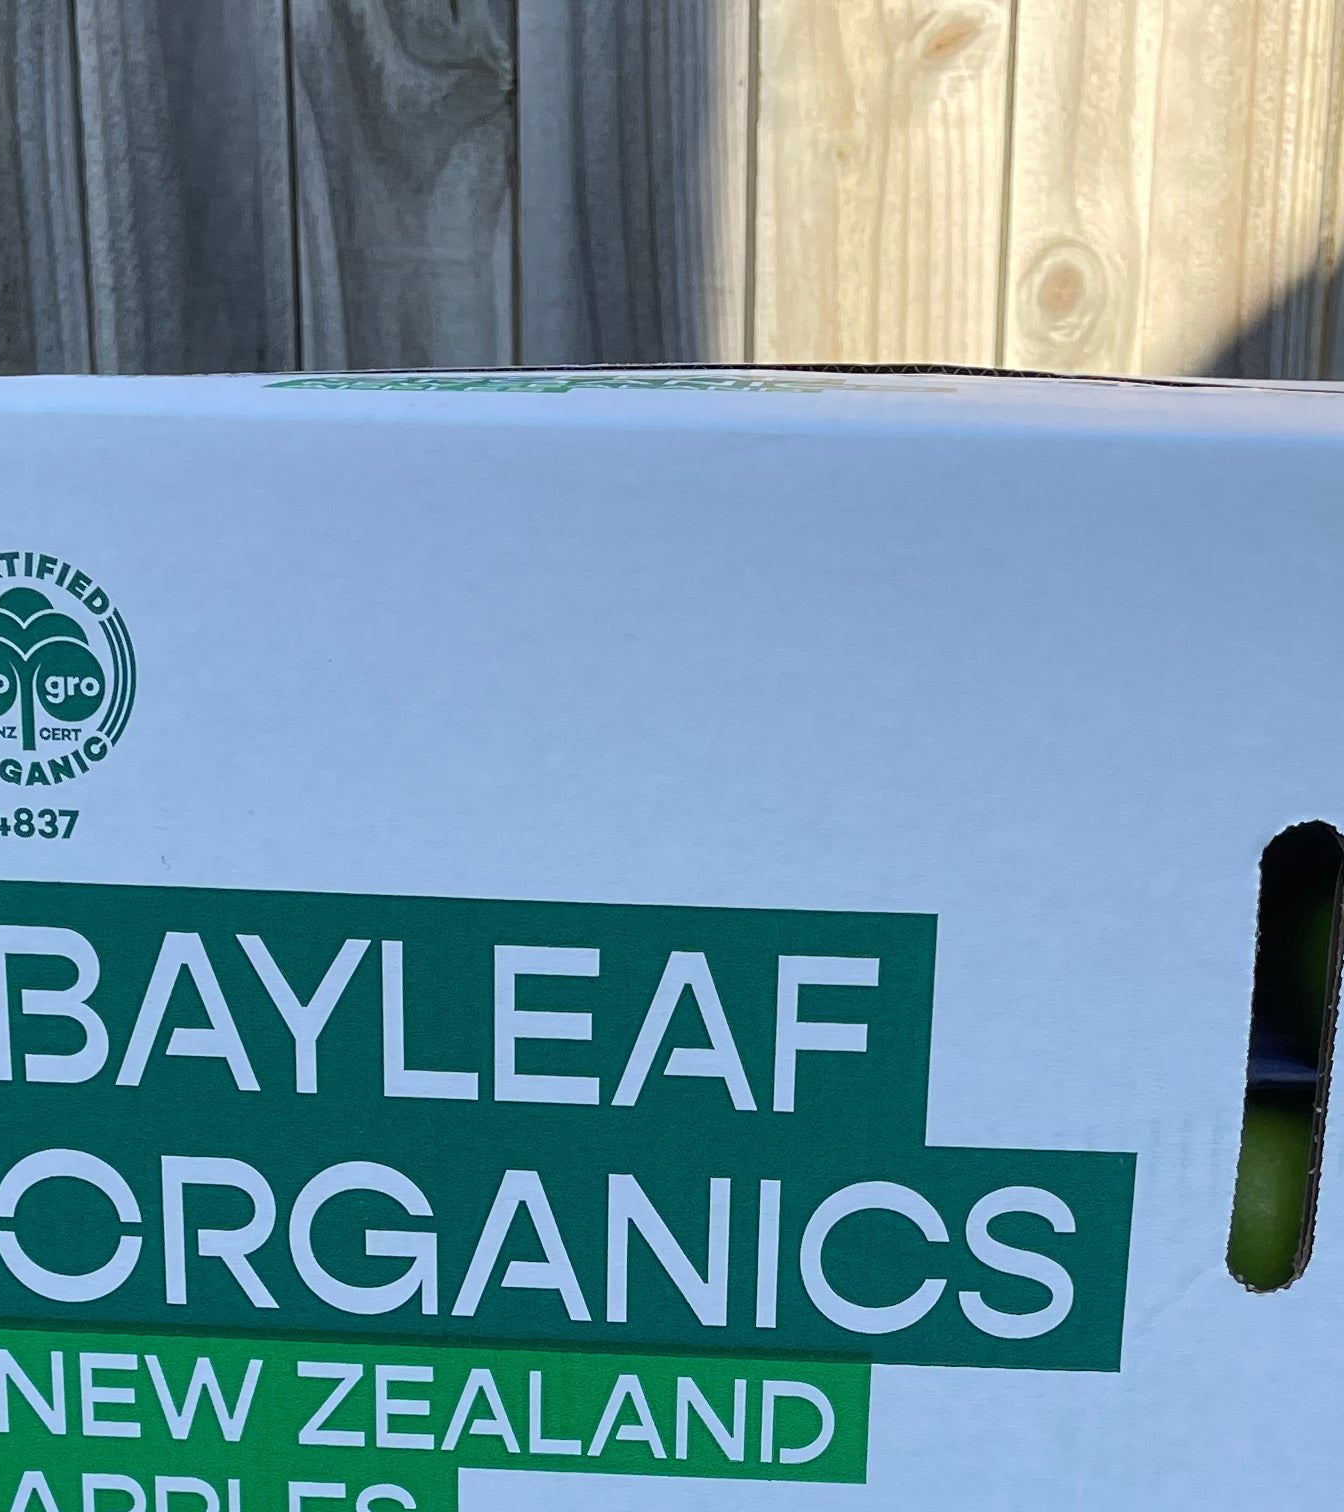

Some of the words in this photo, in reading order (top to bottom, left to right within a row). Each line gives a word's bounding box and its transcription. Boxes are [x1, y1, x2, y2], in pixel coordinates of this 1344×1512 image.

[45, 676, 100, 704] gro
[39, 727, 82, 741] CERT
[297, 1361, 836, 1464] ZEALAND
